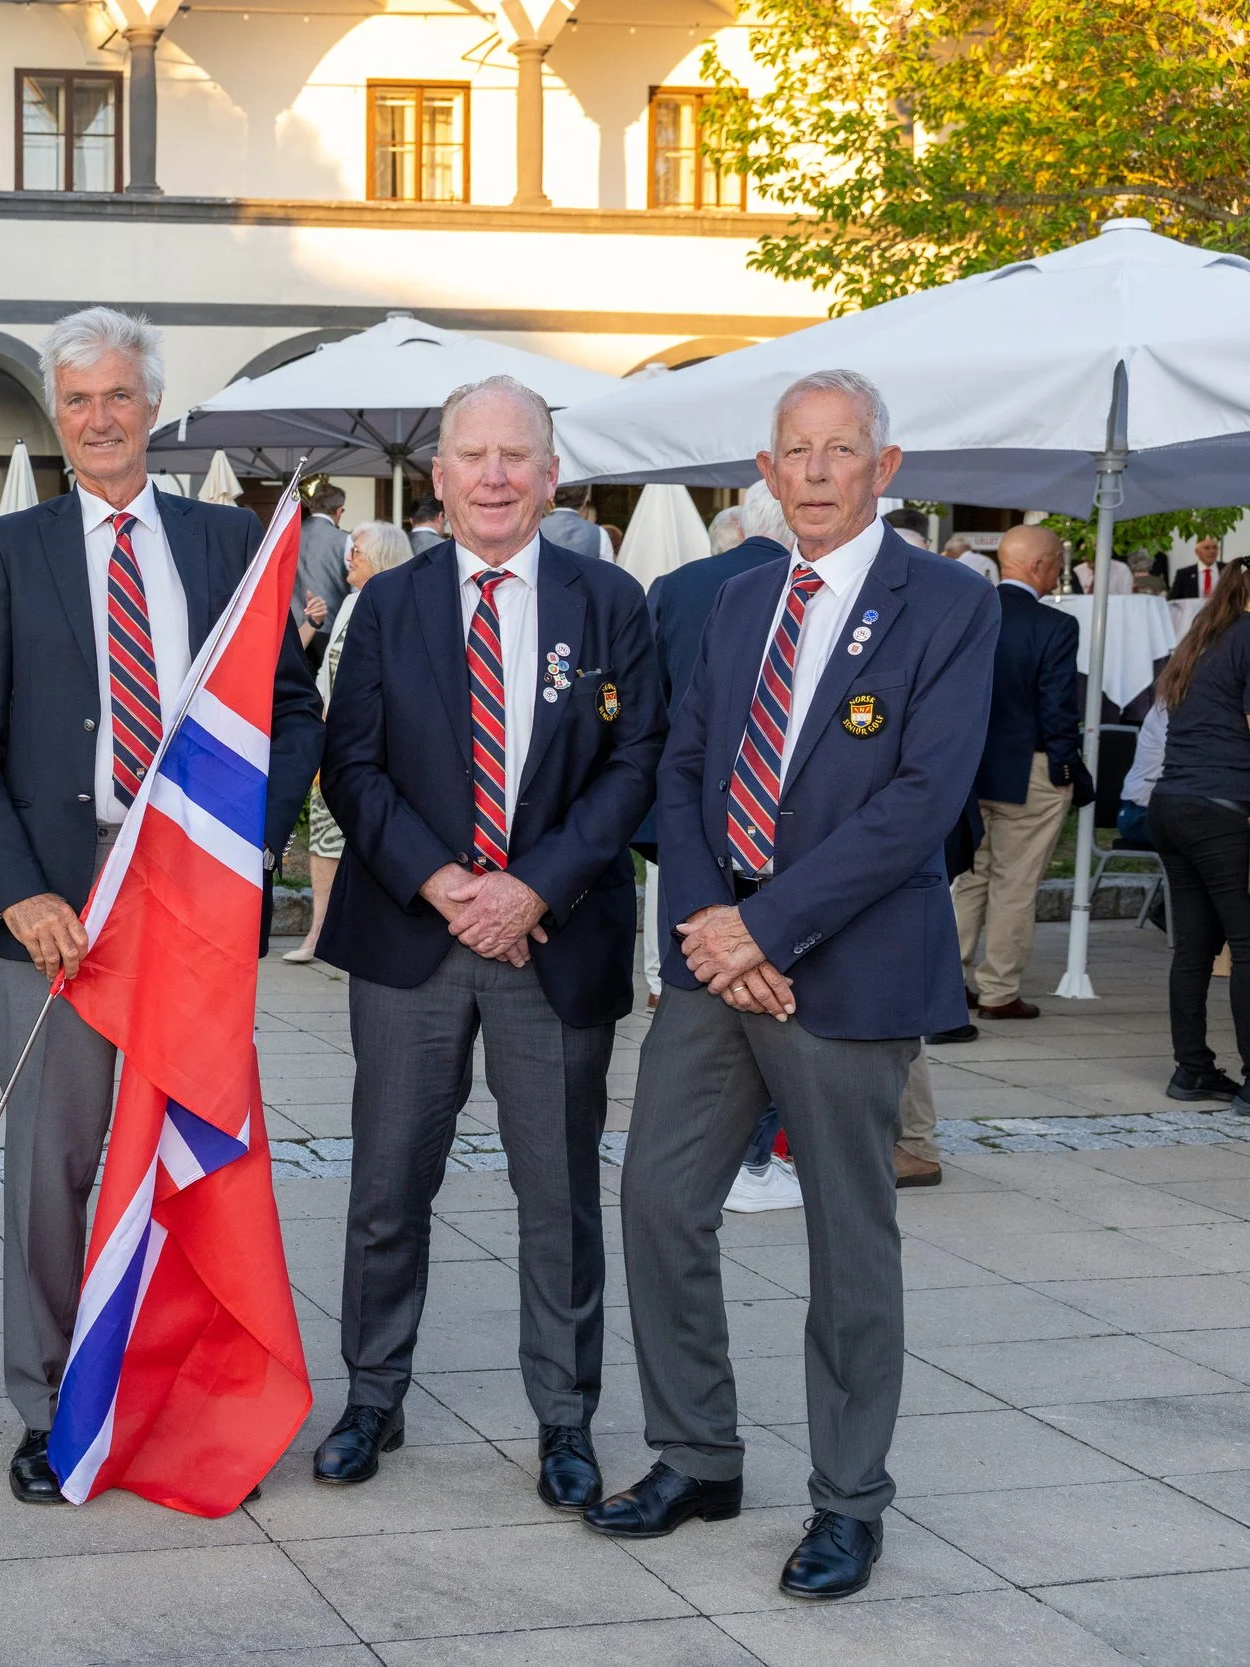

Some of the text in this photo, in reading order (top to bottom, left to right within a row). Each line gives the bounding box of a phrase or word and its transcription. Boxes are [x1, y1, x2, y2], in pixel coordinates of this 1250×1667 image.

[849, 695, 876, 705] NORSK
[842, 714, 884, 735] SENIOR GOLF
